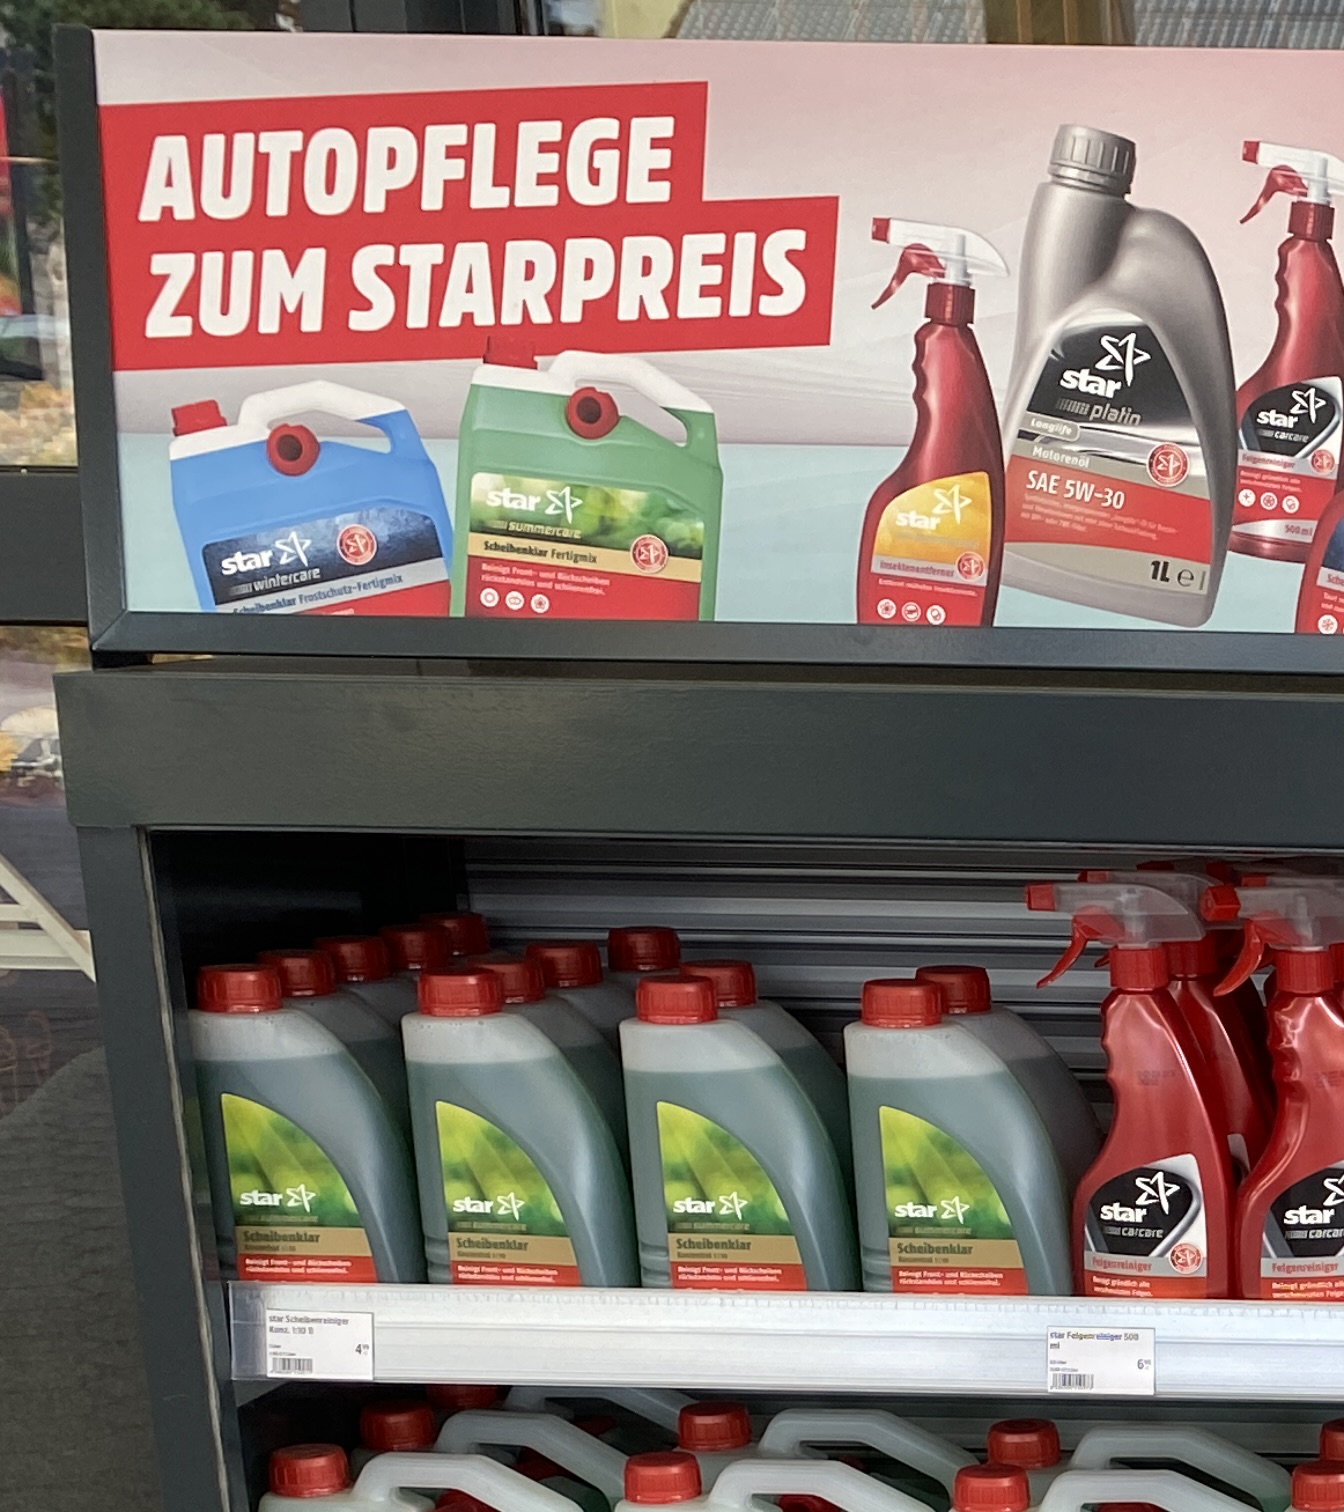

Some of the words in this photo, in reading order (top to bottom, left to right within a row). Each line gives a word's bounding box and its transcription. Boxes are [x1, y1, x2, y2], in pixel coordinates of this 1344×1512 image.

[138, 116, 675, 222] AUTOPFLEGE
[145, 248, 327, 338] ZUM
[348, 228, 807, 333] STARPREIS
[1060, 369, 1121, 399] star
[1089, 402, 1142, 427] platin
[1256, 410, 1298, 428] star
[1032, 444, 1090, 468] Motorenöl
[486, 489, 540, 511] star
[1026, 470, 1060, 496] SAE
[1064, 479, 1125, 510] 5W-30
[896, 510, 941, 531] star
[221, 547, 272, 576] star
[551, 548, 598, 564] Fertigmix
[252, 566, 320, 592] wintercare
[1150, 559, 1171, 584] 1L
[239, 1190, 283, 1207] star
[452, 1197, 493, 1214] star
[673, 1199, 715, 1215] star
[894, 1203, 937, 1218] star
[1100, 1202, 1147, 1223] star
[1284, 1205, 1335, 1224] star
[1121, 1226, 1164, 1239] carcare
[456, 1236, 529, 1252] Scheibenklar
[676, 1237, 751, 1251] Scheibenklar
[897, 1242, 973, 1256] Scheibenklar
